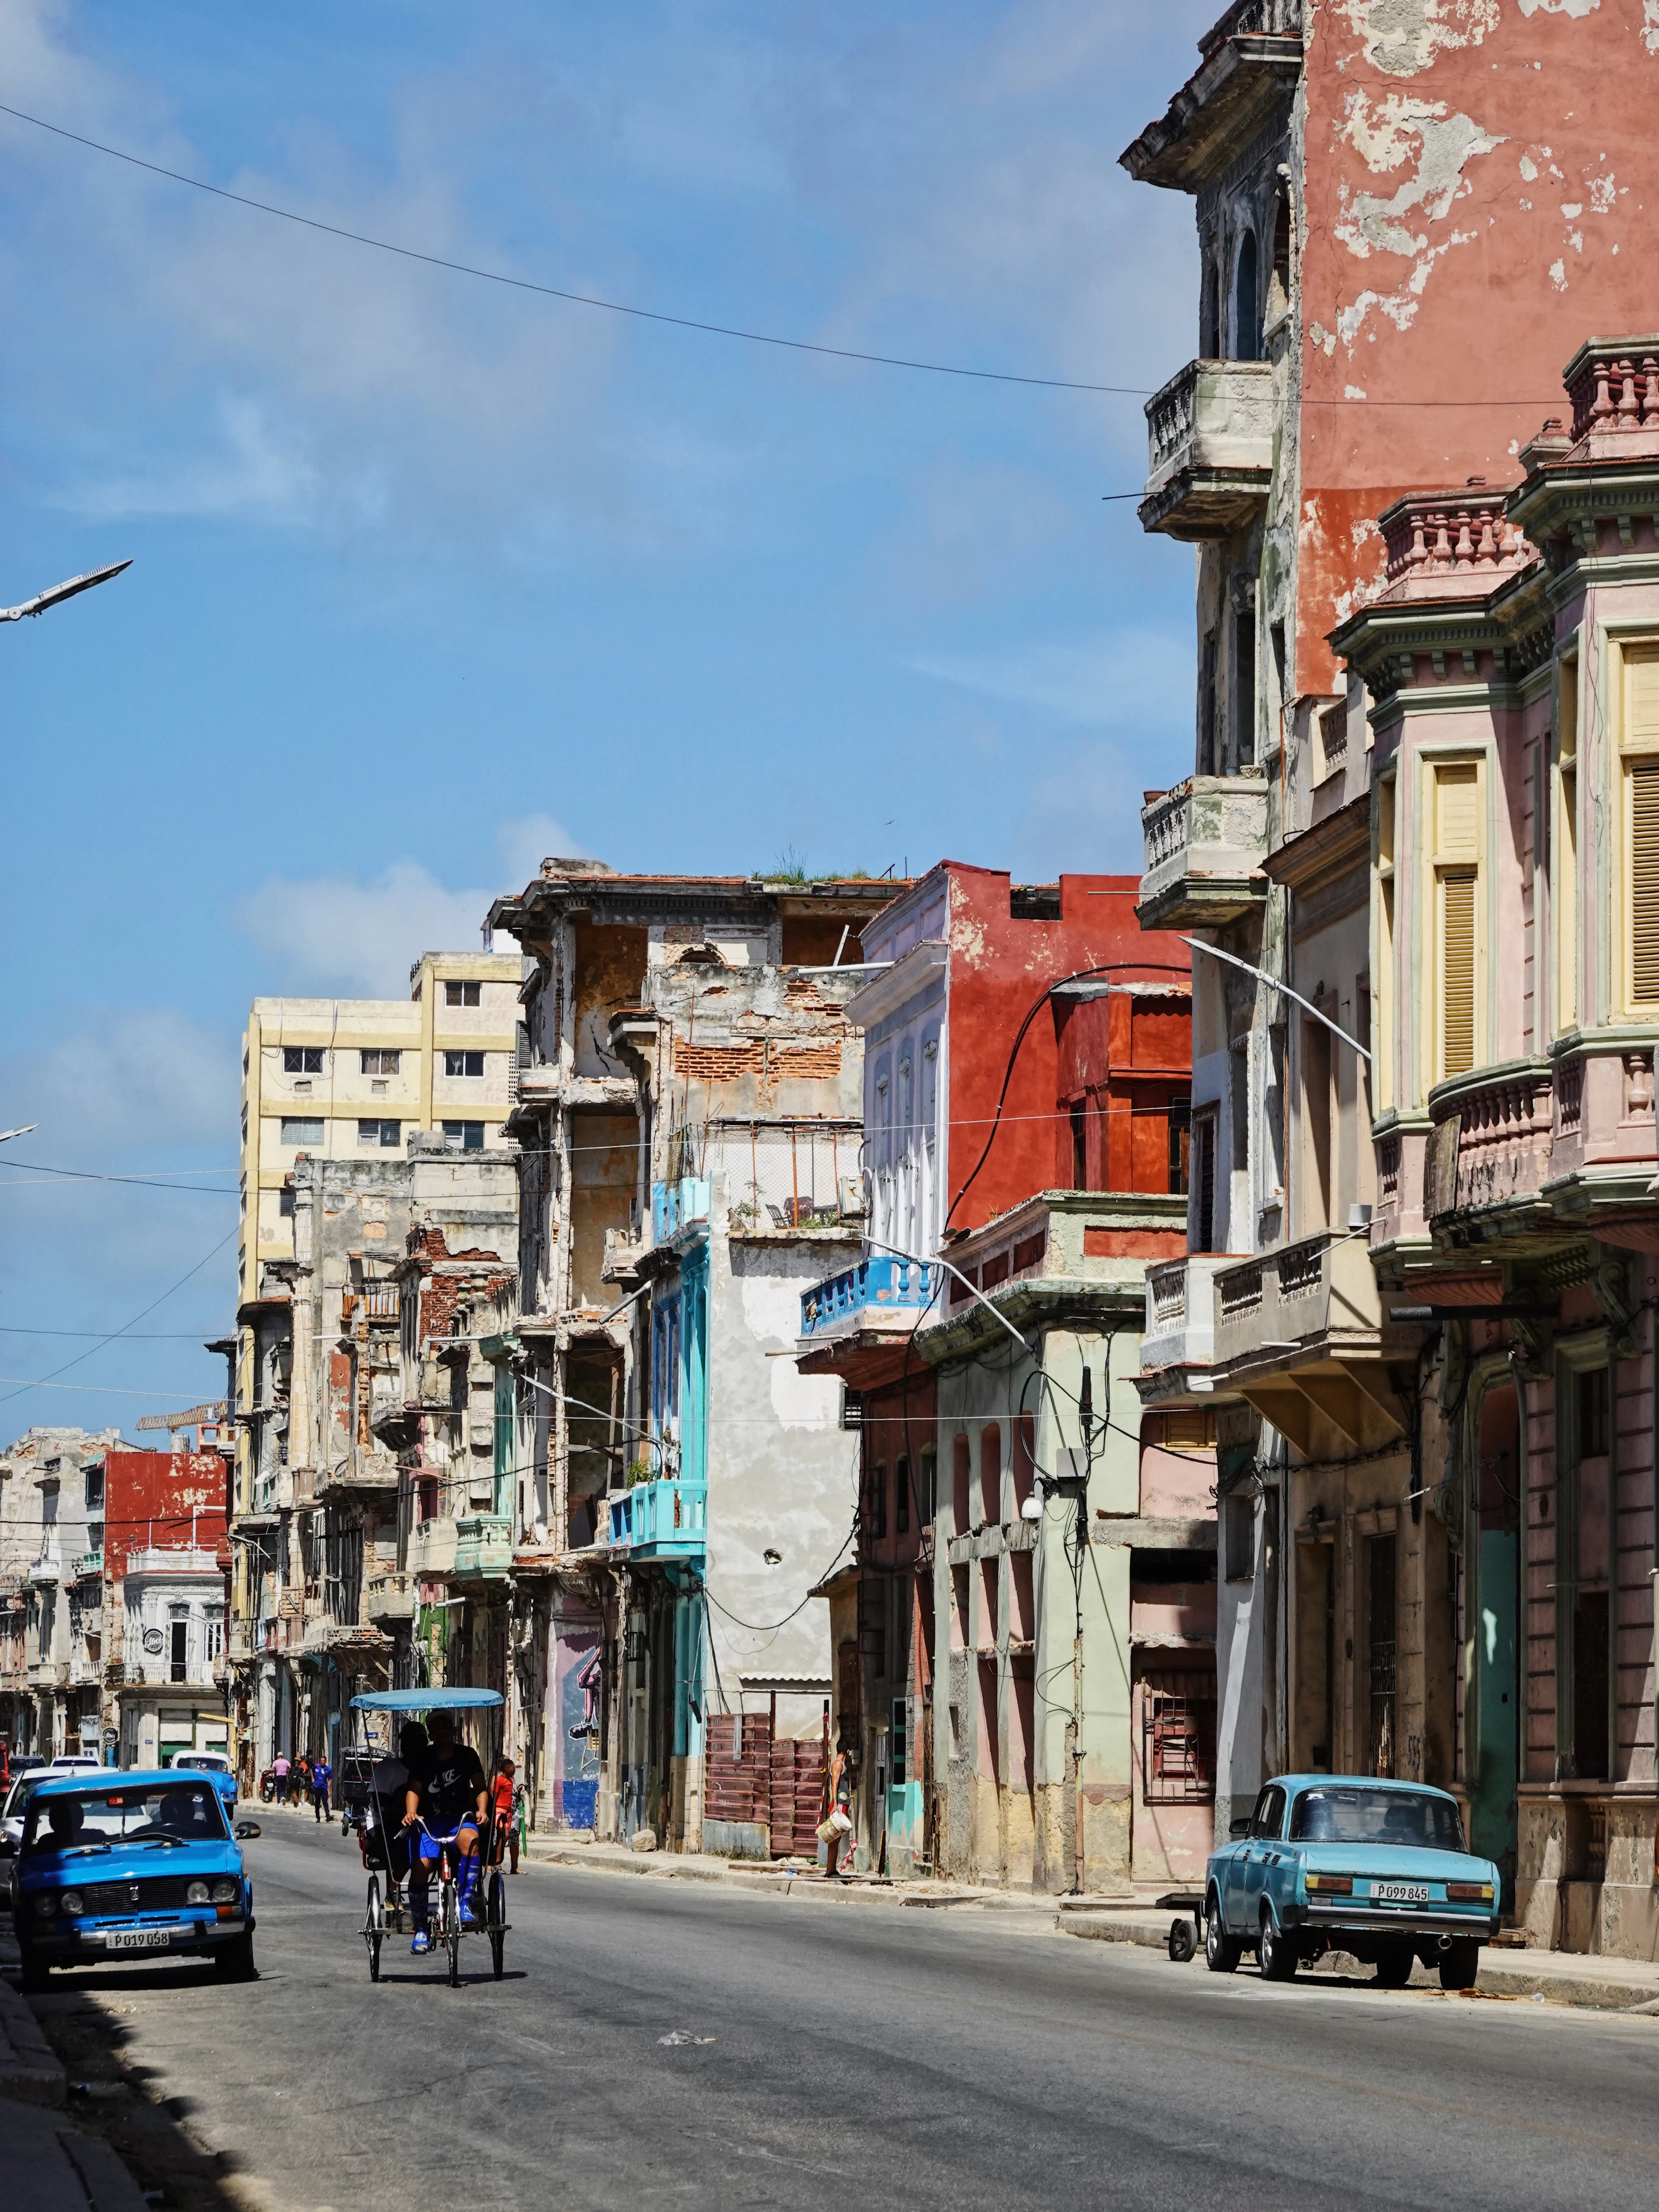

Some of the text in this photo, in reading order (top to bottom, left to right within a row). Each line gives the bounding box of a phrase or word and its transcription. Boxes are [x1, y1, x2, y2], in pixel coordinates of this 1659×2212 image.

[1378, 1885, 1427, 1900] P 099 845
[115, 1935, 121, 1947] P
[124, 1934, 144, 1946] 019
[147, 1933, 168, 1945] 058
